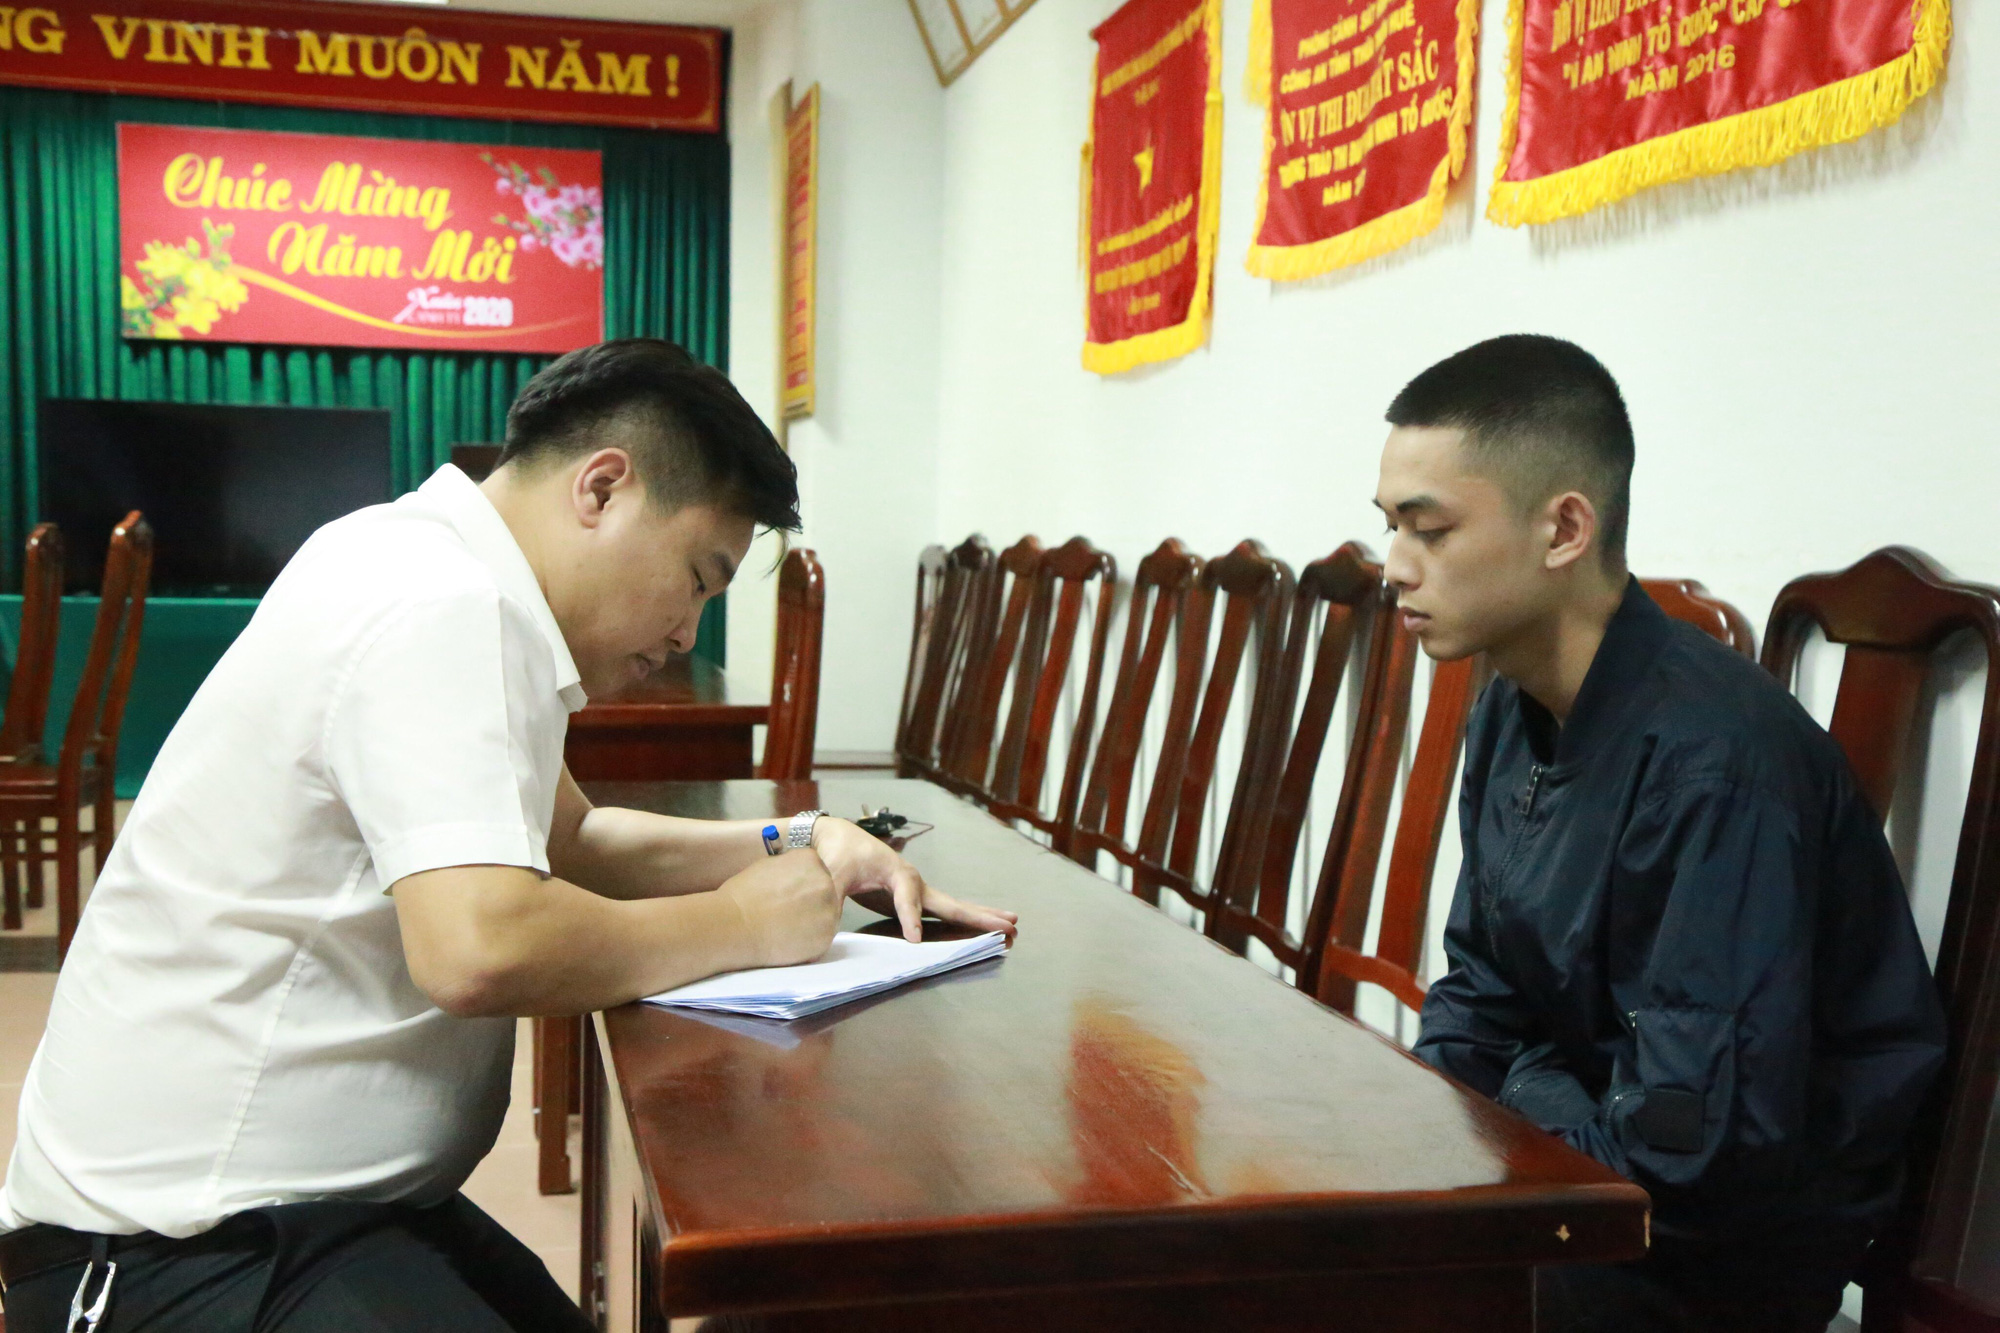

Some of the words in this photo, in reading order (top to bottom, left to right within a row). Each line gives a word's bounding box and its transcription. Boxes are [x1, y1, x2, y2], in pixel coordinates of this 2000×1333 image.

[91, 14, 271, 70] VINH
[295, 27, 482, 85] MUÔN
[1397, 25, 1439, 92] SẮC
[1580, 51, 1605, 86] AN
[1646, 5, 1672, 57] TỔ
[1625, 64, 1679, 101] NĂM
[1684, 43, 1736, 84] 2016
[163, 152, 293, 212] Chúc
[299, 161, 454, 231] Mừng
[267, 220, 405, 279] Năm
[412, 229, 516, 284] Mới
